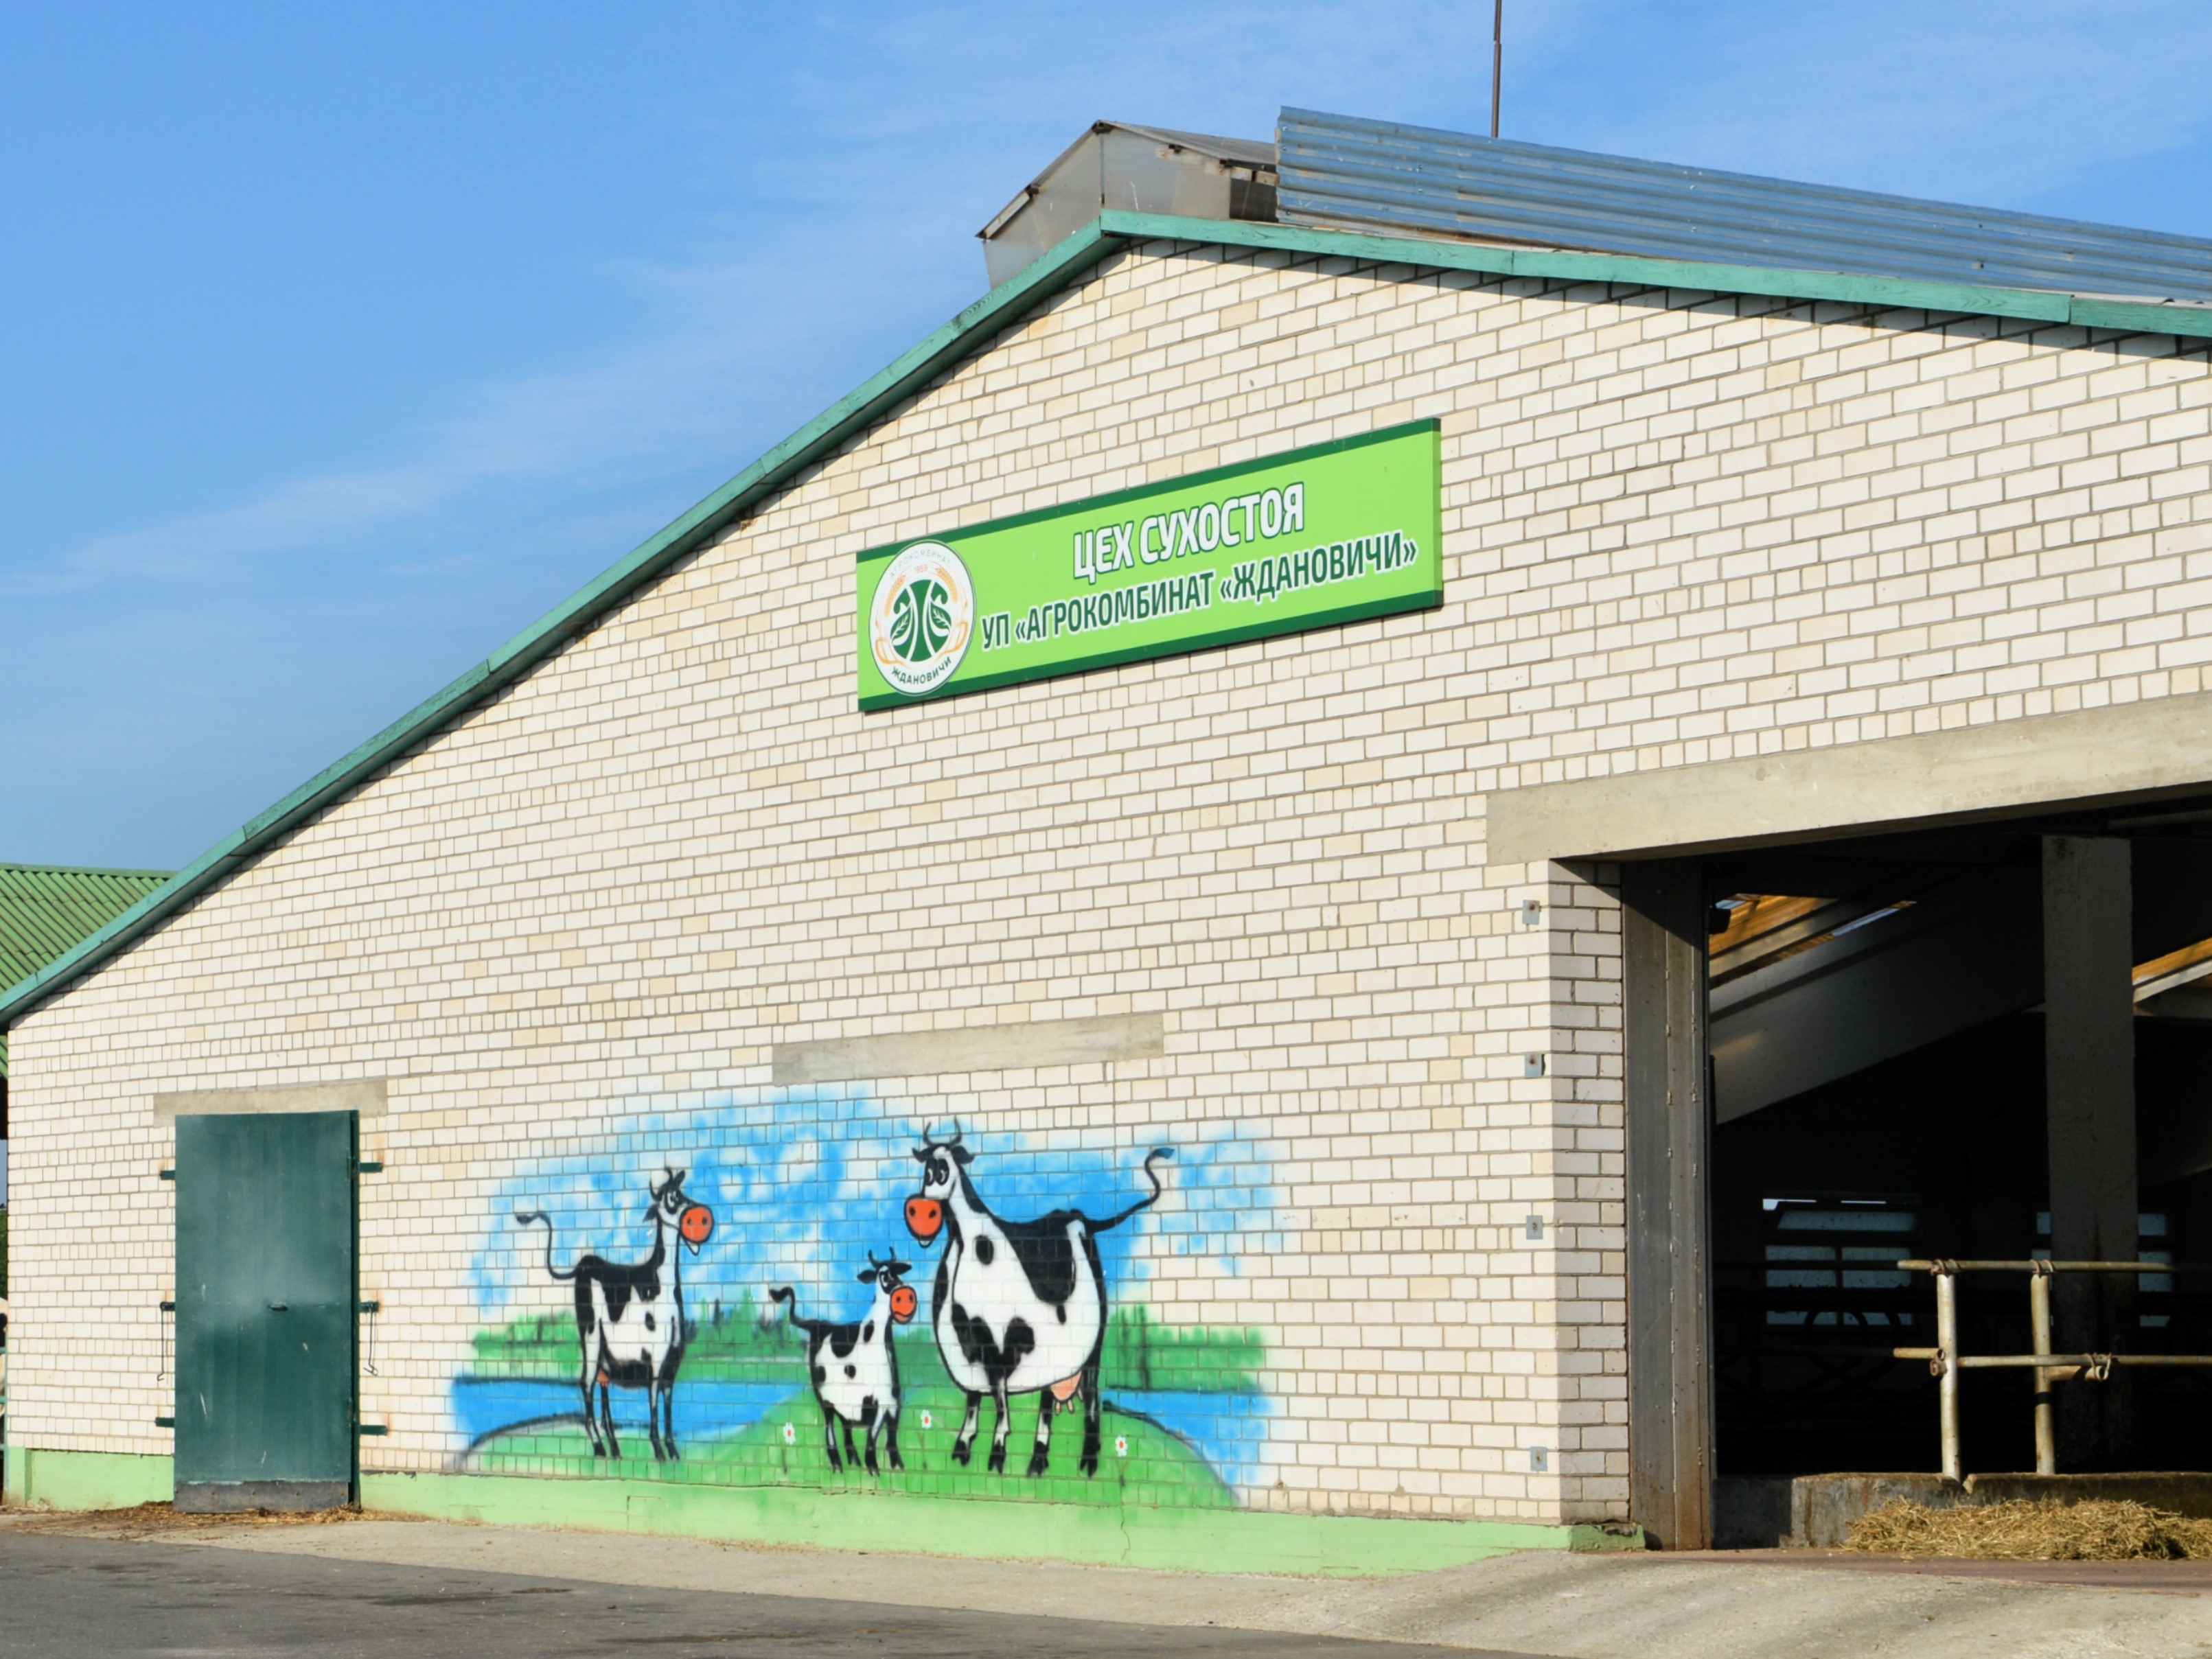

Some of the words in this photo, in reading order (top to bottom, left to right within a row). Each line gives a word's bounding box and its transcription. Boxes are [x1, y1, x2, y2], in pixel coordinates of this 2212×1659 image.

[1073, 520, 1134, 585] ЦЕХ
[1140, 481, 1304, 564] СУХОСТОЯ
[982, 613, 1009, 650] УП
[1015, 572, 1214, 641] «АГРОКОМБИНАТ
[1220, 531, 1416, 603] «ЖДАНОВИЧИ»
[892, 656, 952, 684] ЖДАНОВИЧИ
